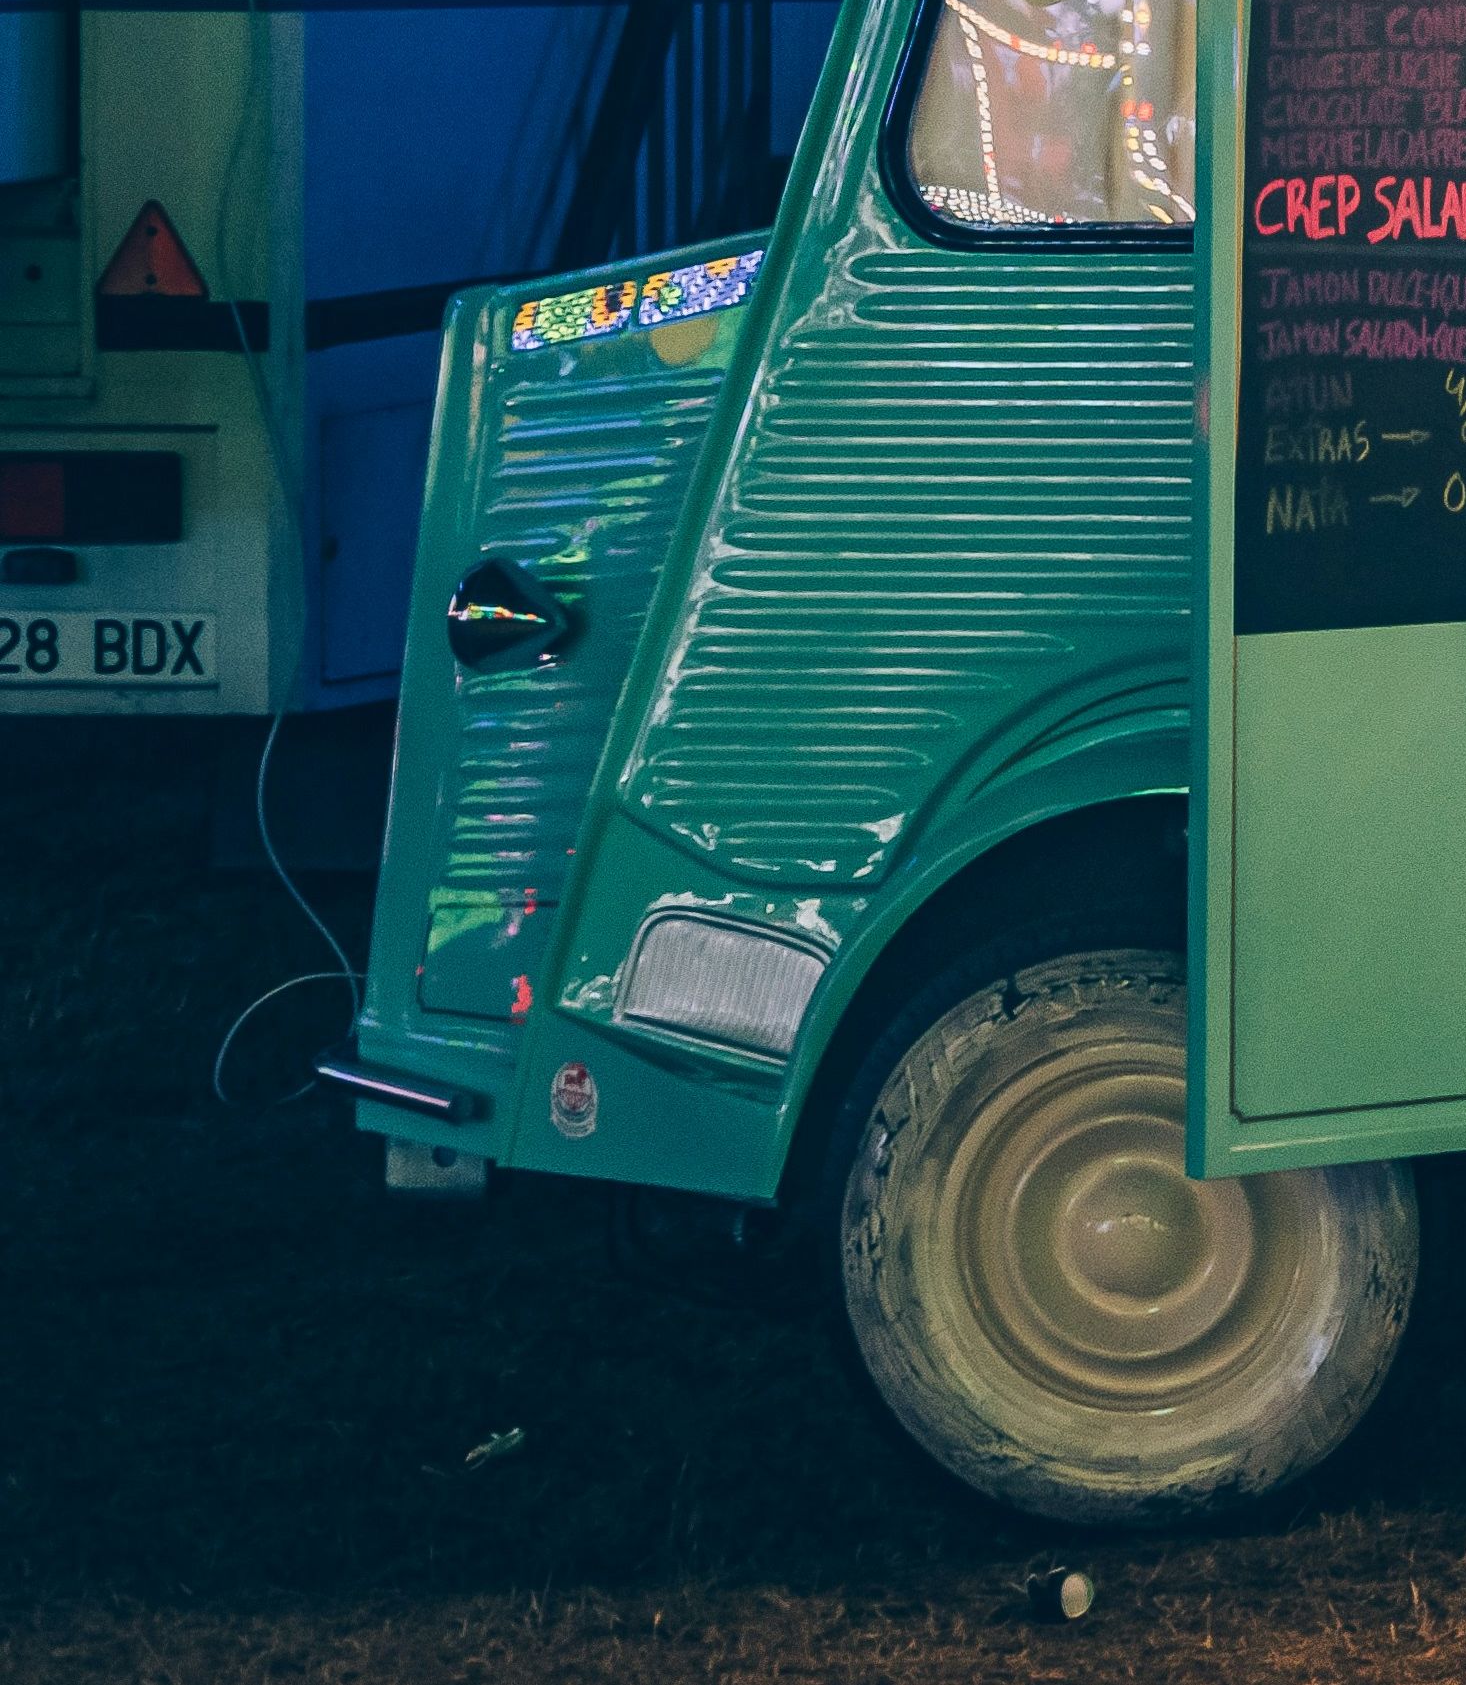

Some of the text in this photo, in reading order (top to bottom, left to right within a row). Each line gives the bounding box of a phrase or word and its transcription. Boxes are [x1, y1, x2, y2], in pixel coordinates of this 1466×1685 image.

[1268, 4, 1381, 51] LECHE
[1255, 175, 1361, 240] CREP
[1258, 267, 1361, 310] JAMON
[1257, 319, 1341, 363] JAMON
[1265, 369, 1354, 413] ATUN
[1265, 476, 1351, 535] NATA
[94, 618, 205, 675] BDX
